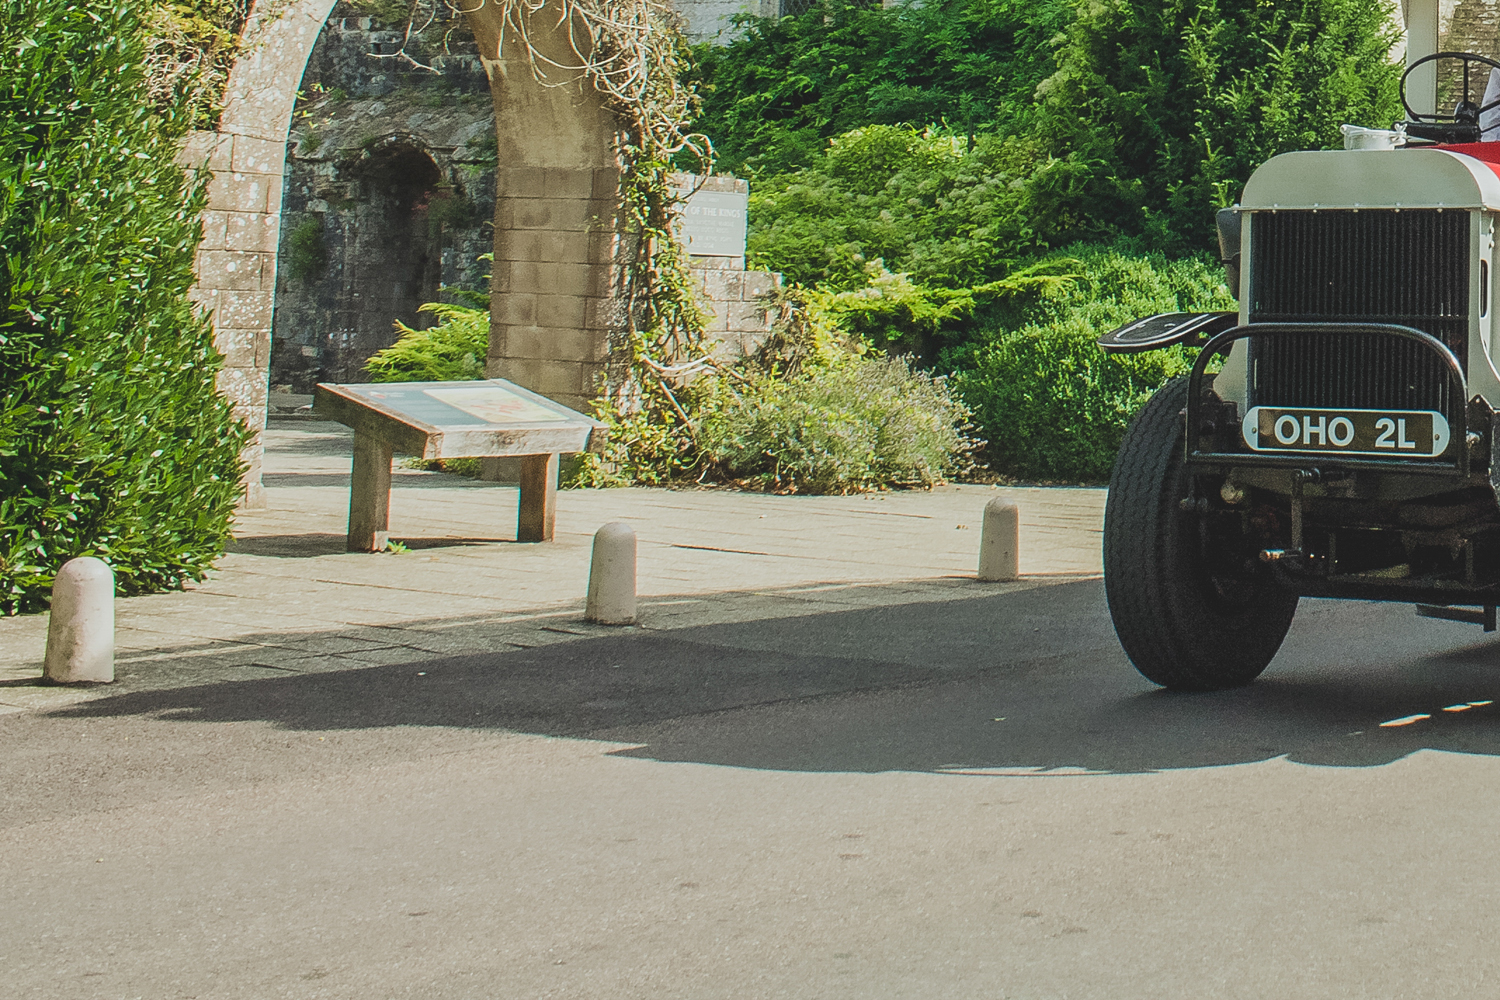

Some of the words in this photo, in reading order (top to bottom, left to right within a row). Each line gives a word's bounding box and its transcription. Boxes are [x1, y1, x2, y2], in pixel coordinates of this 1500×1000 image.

[703, 207, 717, 216] THE
[719, 208, 740, 218] KINGS
[1274, 414, 1355, 447] OHO
[1375, 417, 1416, 449] 2L
